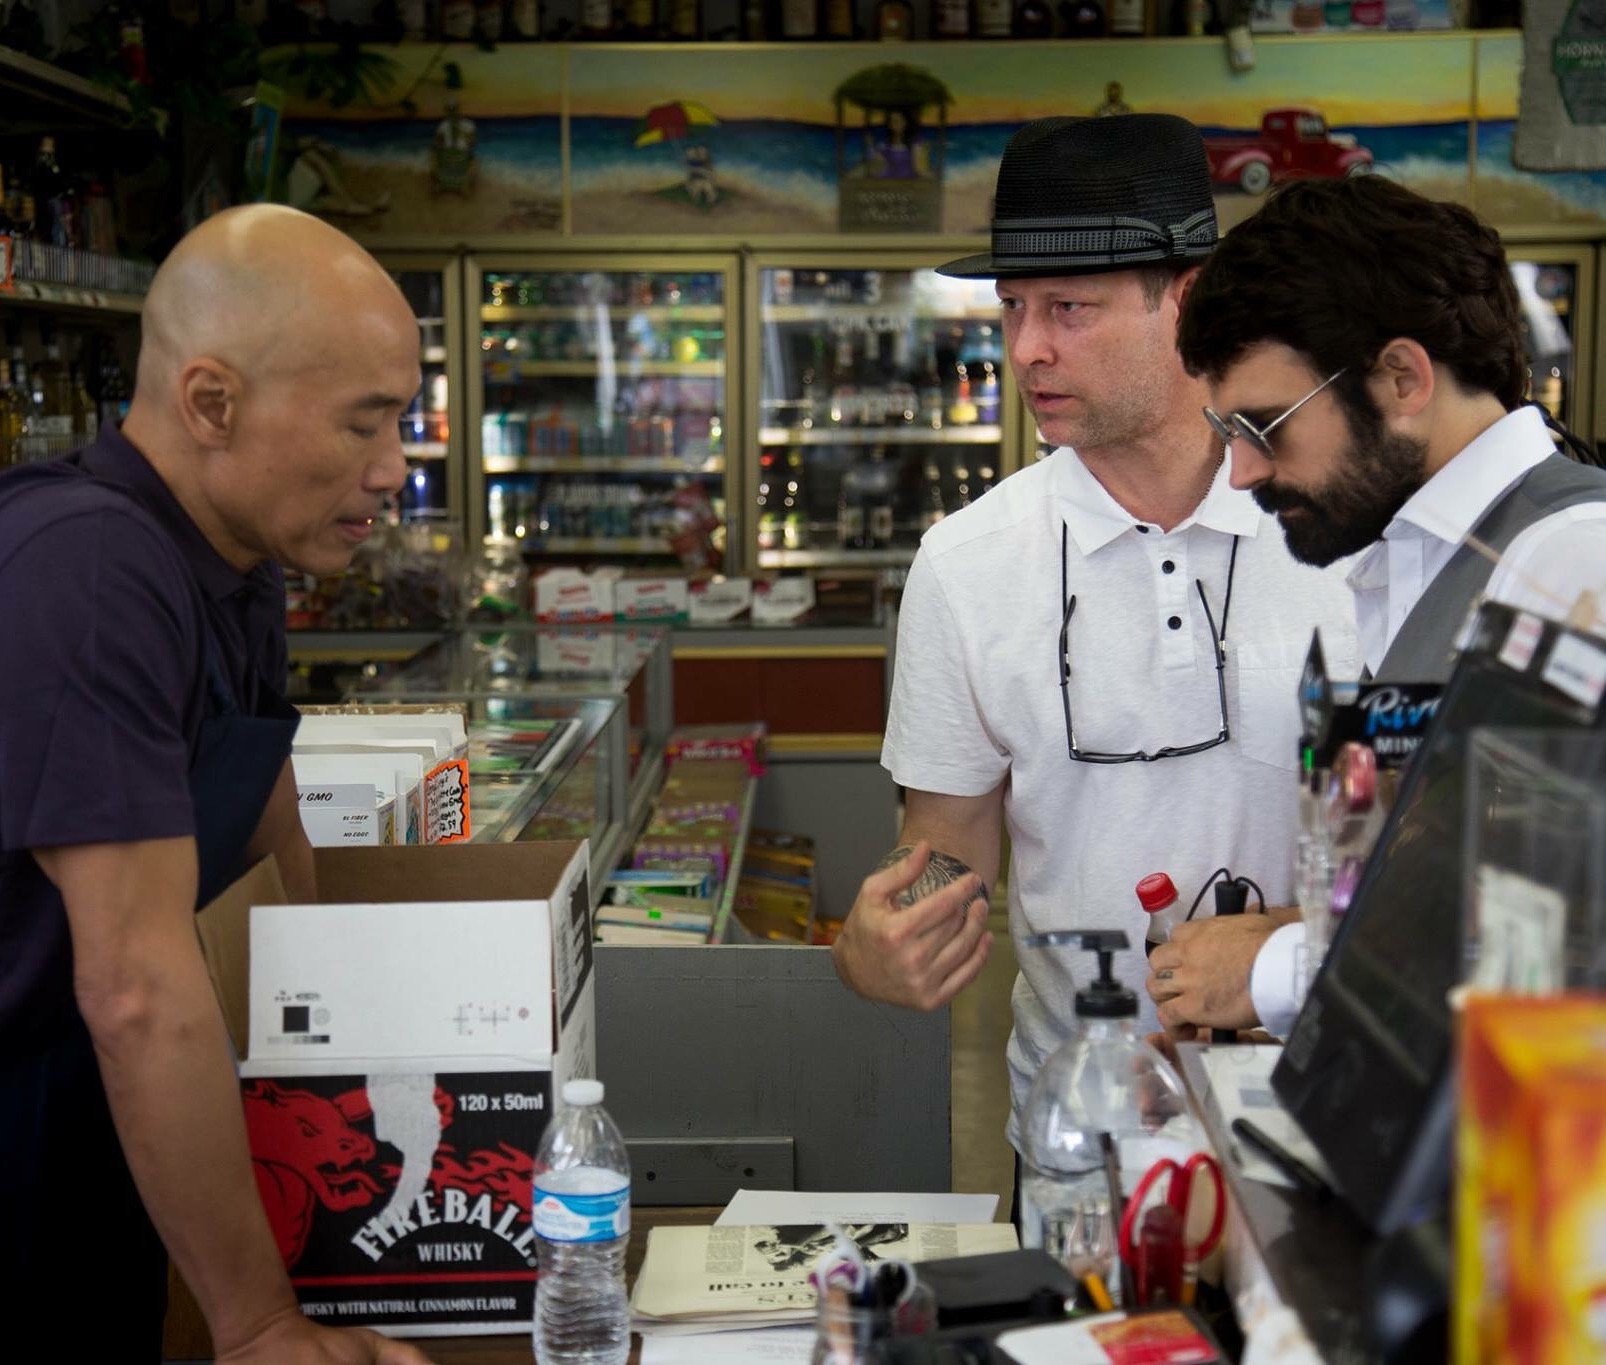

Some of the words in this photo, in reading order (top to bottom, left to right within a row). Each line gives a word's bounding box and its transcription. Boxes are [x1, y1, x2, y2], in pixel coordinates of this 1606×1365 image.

[305, 791, 333, 802] GMO
[459, 1094, 488, 1111] 120
[491, 1098, 501, 1110] x
[504, 1092, 544, 1111] 50ml
[417, 1242, 485, 1263] WHISKY
[301, 1302, 335, 1316] HISKY
[337, 1301, 367, 1315] WITH
[369, 1299, 417, 1314] NATURAL
[419, 1298, 475, 1312] CINNAMON
[476, 1297, 517, 1311] FLAVOR
